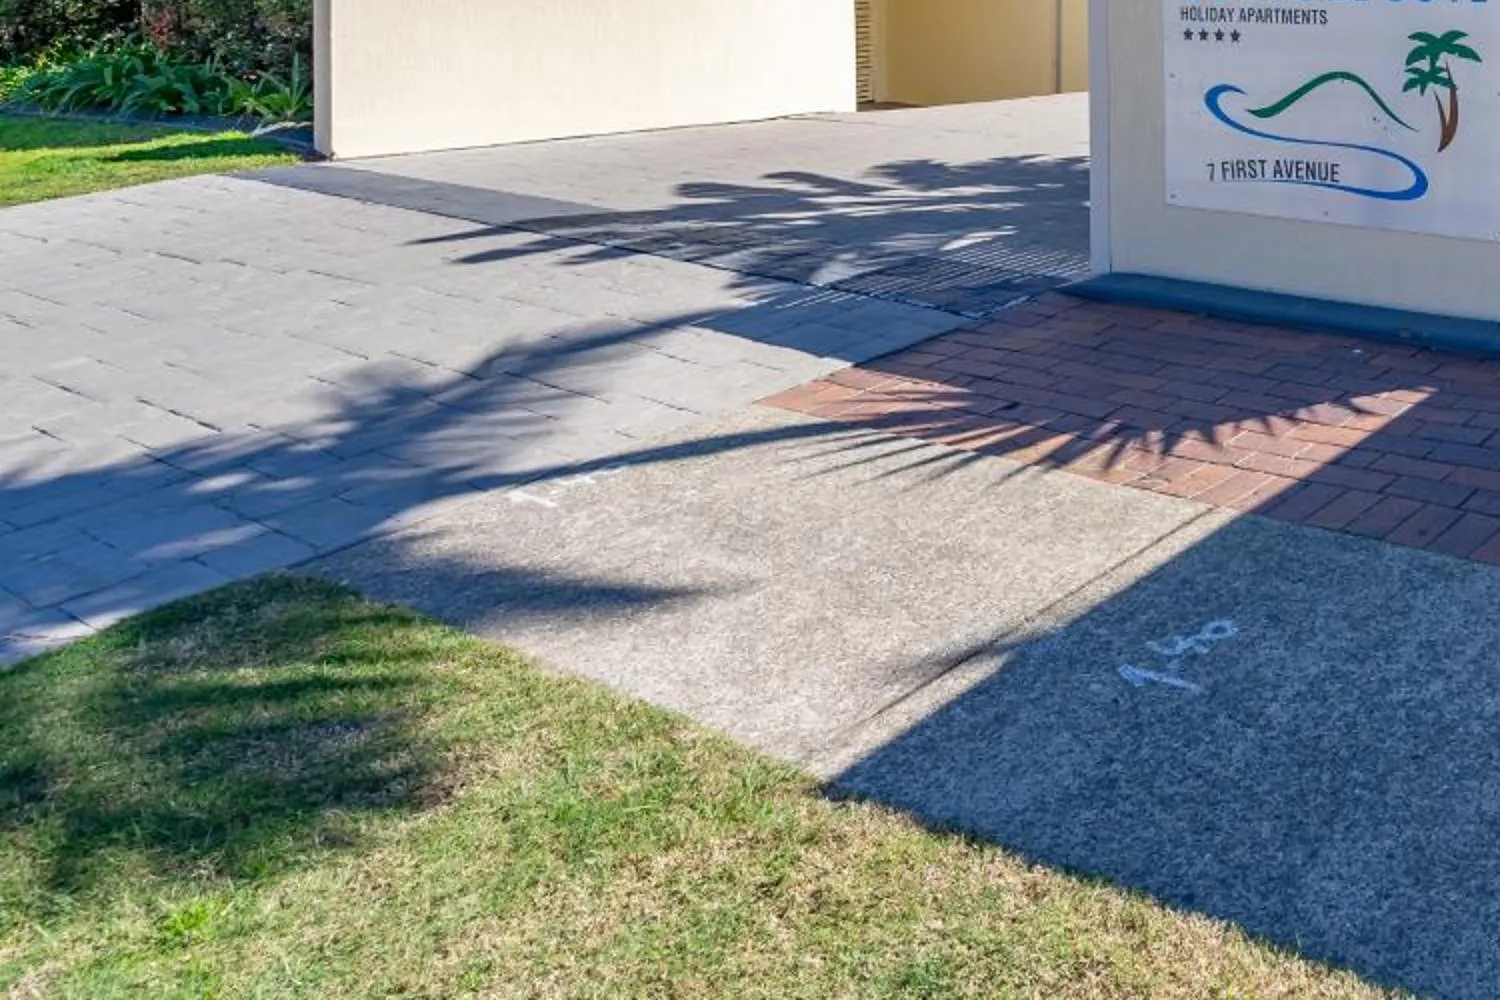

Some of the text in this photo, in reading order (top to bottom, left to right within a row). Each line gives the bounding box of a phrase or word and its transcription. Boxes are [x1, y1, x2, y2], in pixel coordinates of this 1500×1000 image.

[1180, 6, 1328, 25] HOLIDAY APARTMENTS
[1206, 159, 1341, 183] 7 FIRST AVENUE
